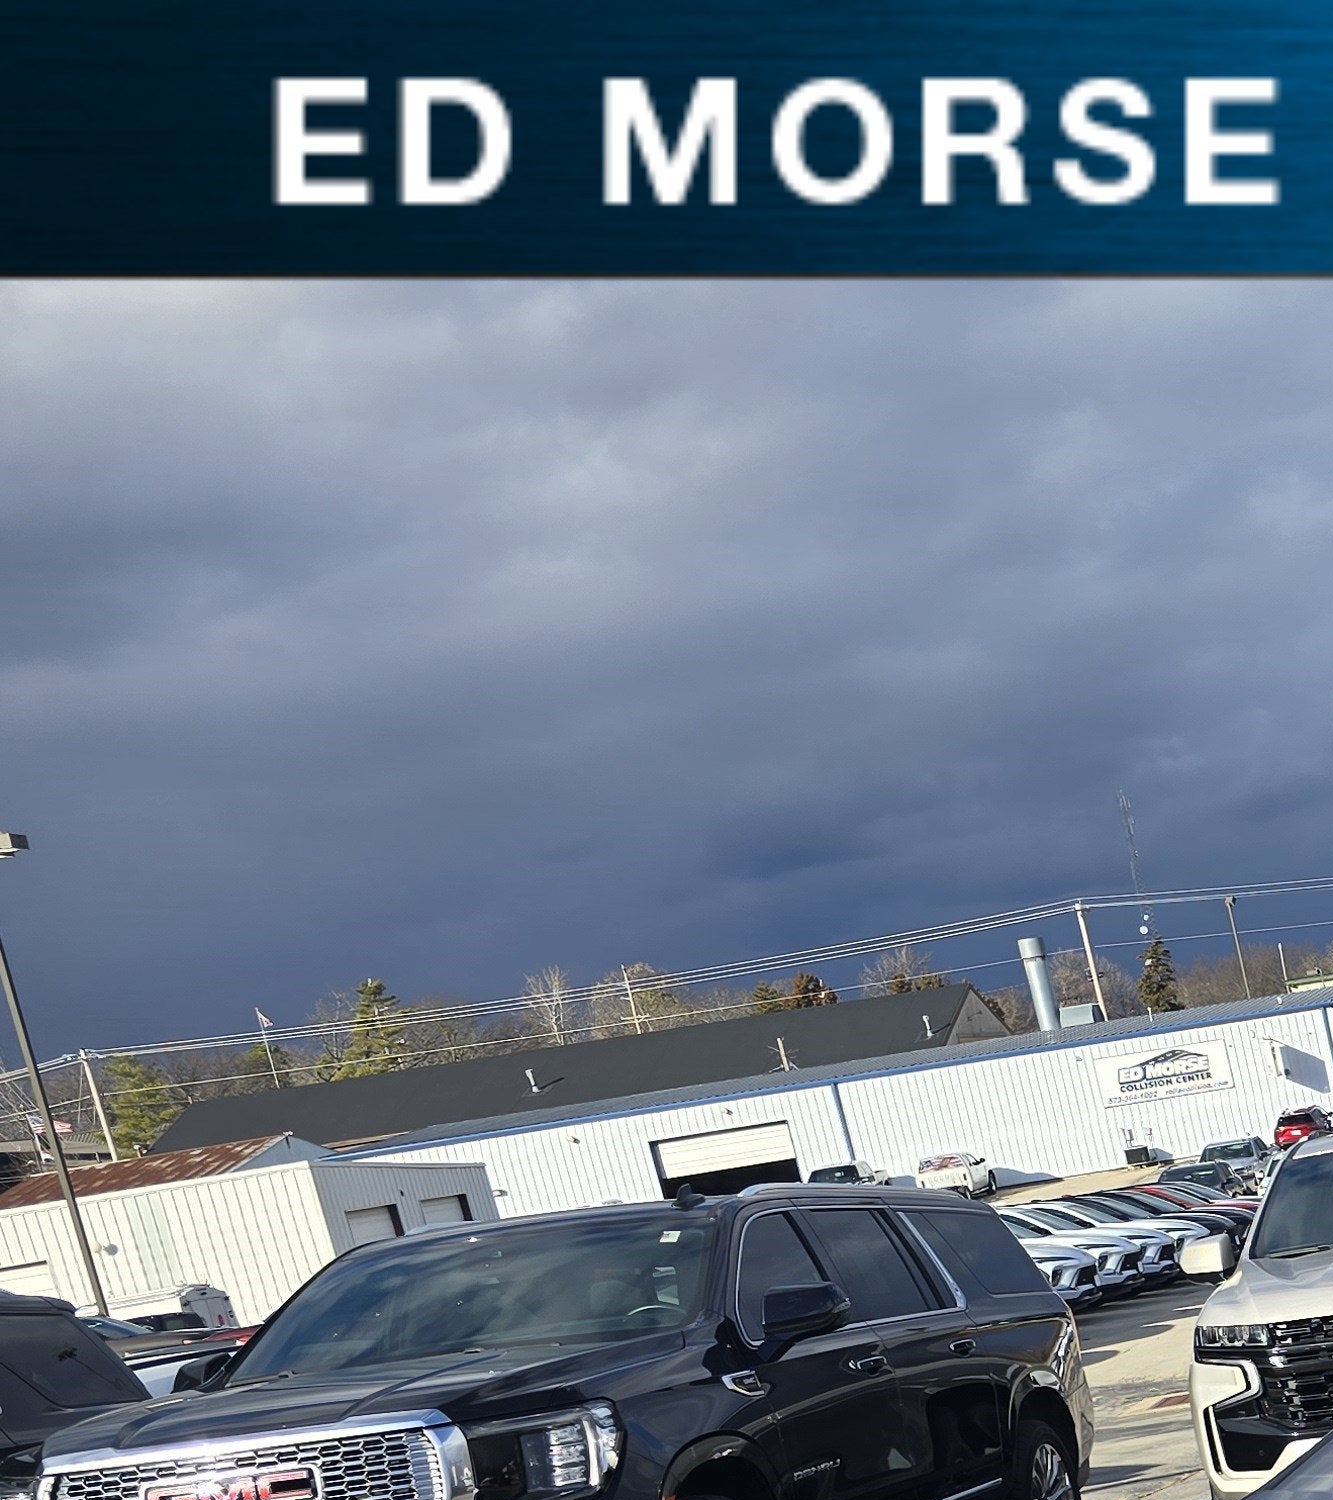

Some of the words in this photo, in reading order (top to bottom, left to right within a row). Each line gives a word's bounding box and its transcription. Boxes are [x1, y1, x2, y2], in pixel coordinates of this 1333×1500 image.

[1118, 1065, 1143, 1084] ED
[1144, 1055, 1210, 1080] MORSE
[1120, 1079, 1174, 1093] COLLISION
[1175, 1071, 1213, 1084] CENTER
